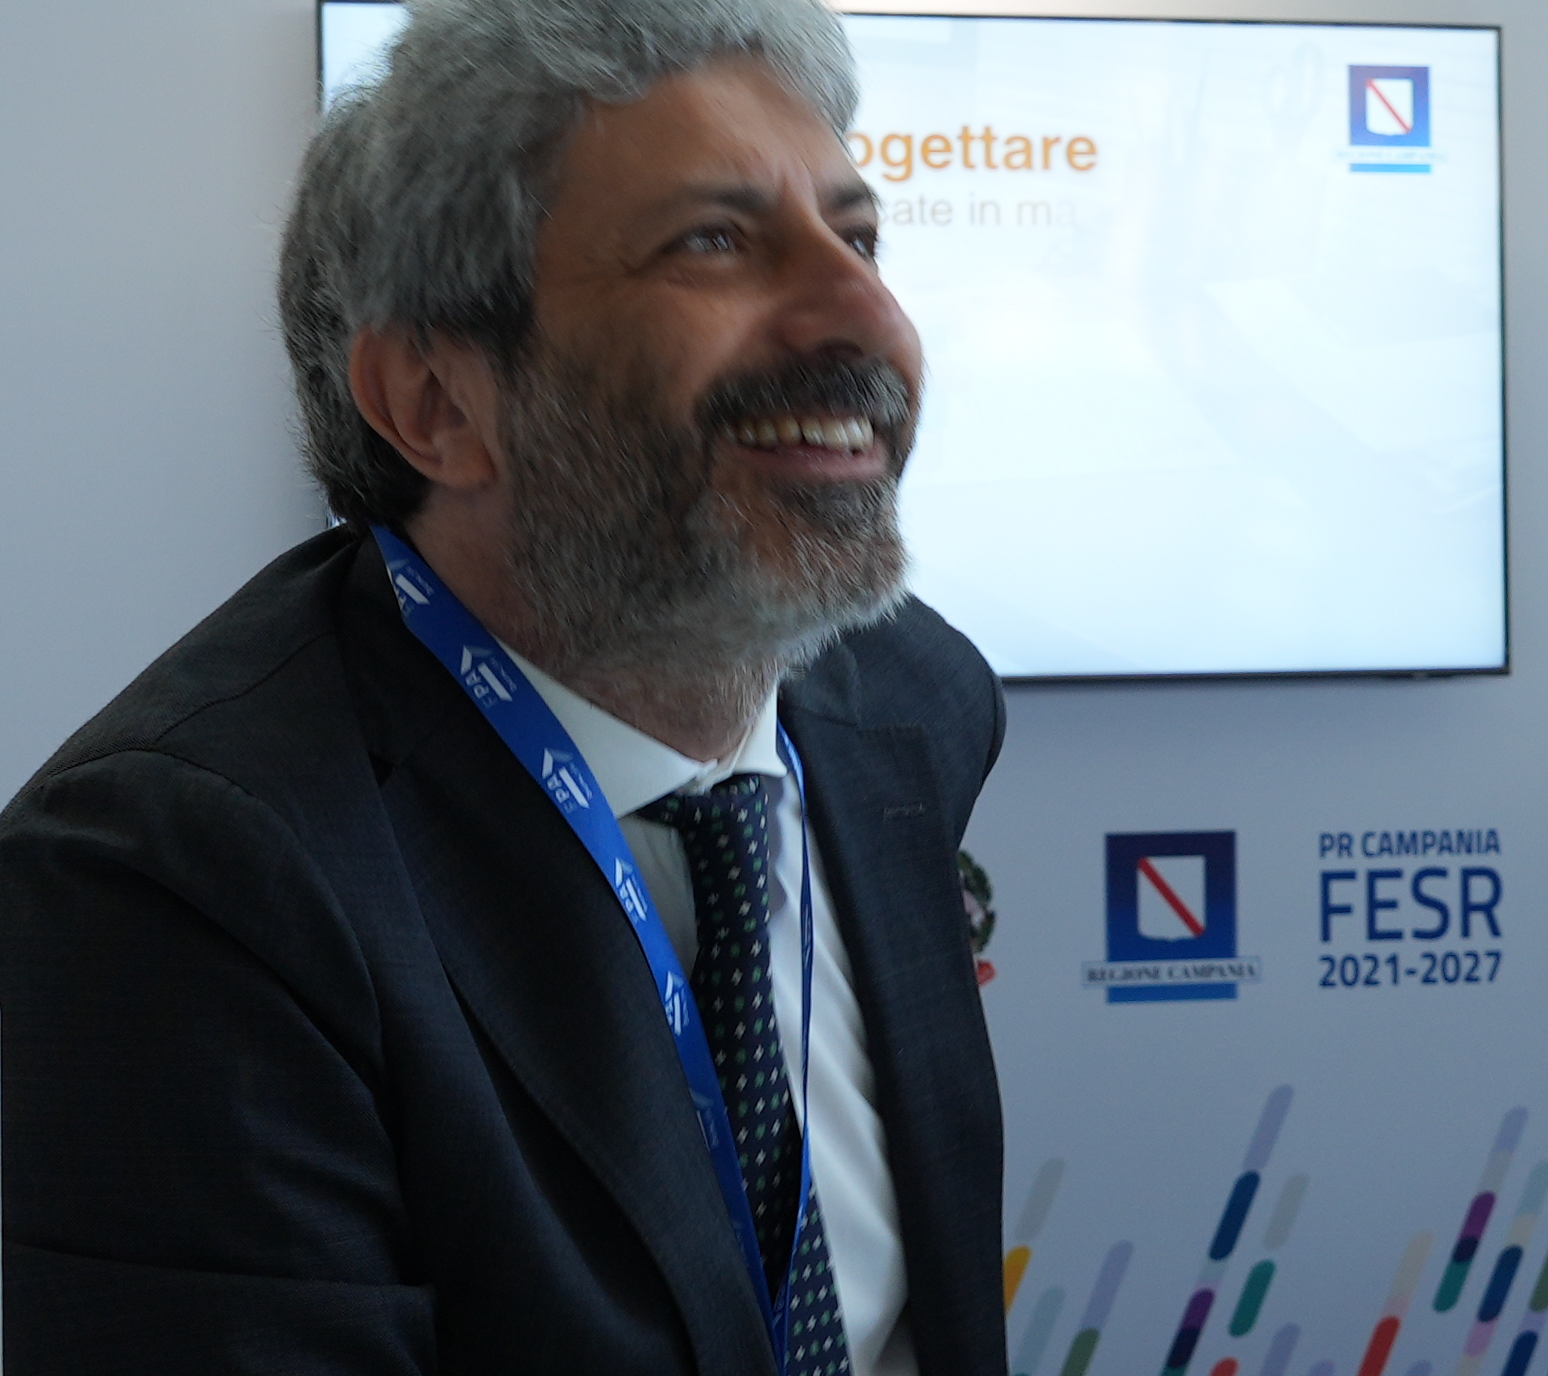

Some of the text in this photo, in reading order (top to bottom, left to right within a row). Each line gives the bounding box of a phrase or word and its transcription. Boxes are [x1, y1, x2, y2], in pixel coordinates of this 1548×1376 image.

[849, 124, 1099, 182] ogettare
[968, 190, 1001, 226] in
[1319, 829, 1501, 858] PR CAMPANIA
[1319, 866, 1504, 943] FESR
[1167, 958, 1258, 980] CAMPANIA
[1318, 949, 1503, 988] 2021-2027
